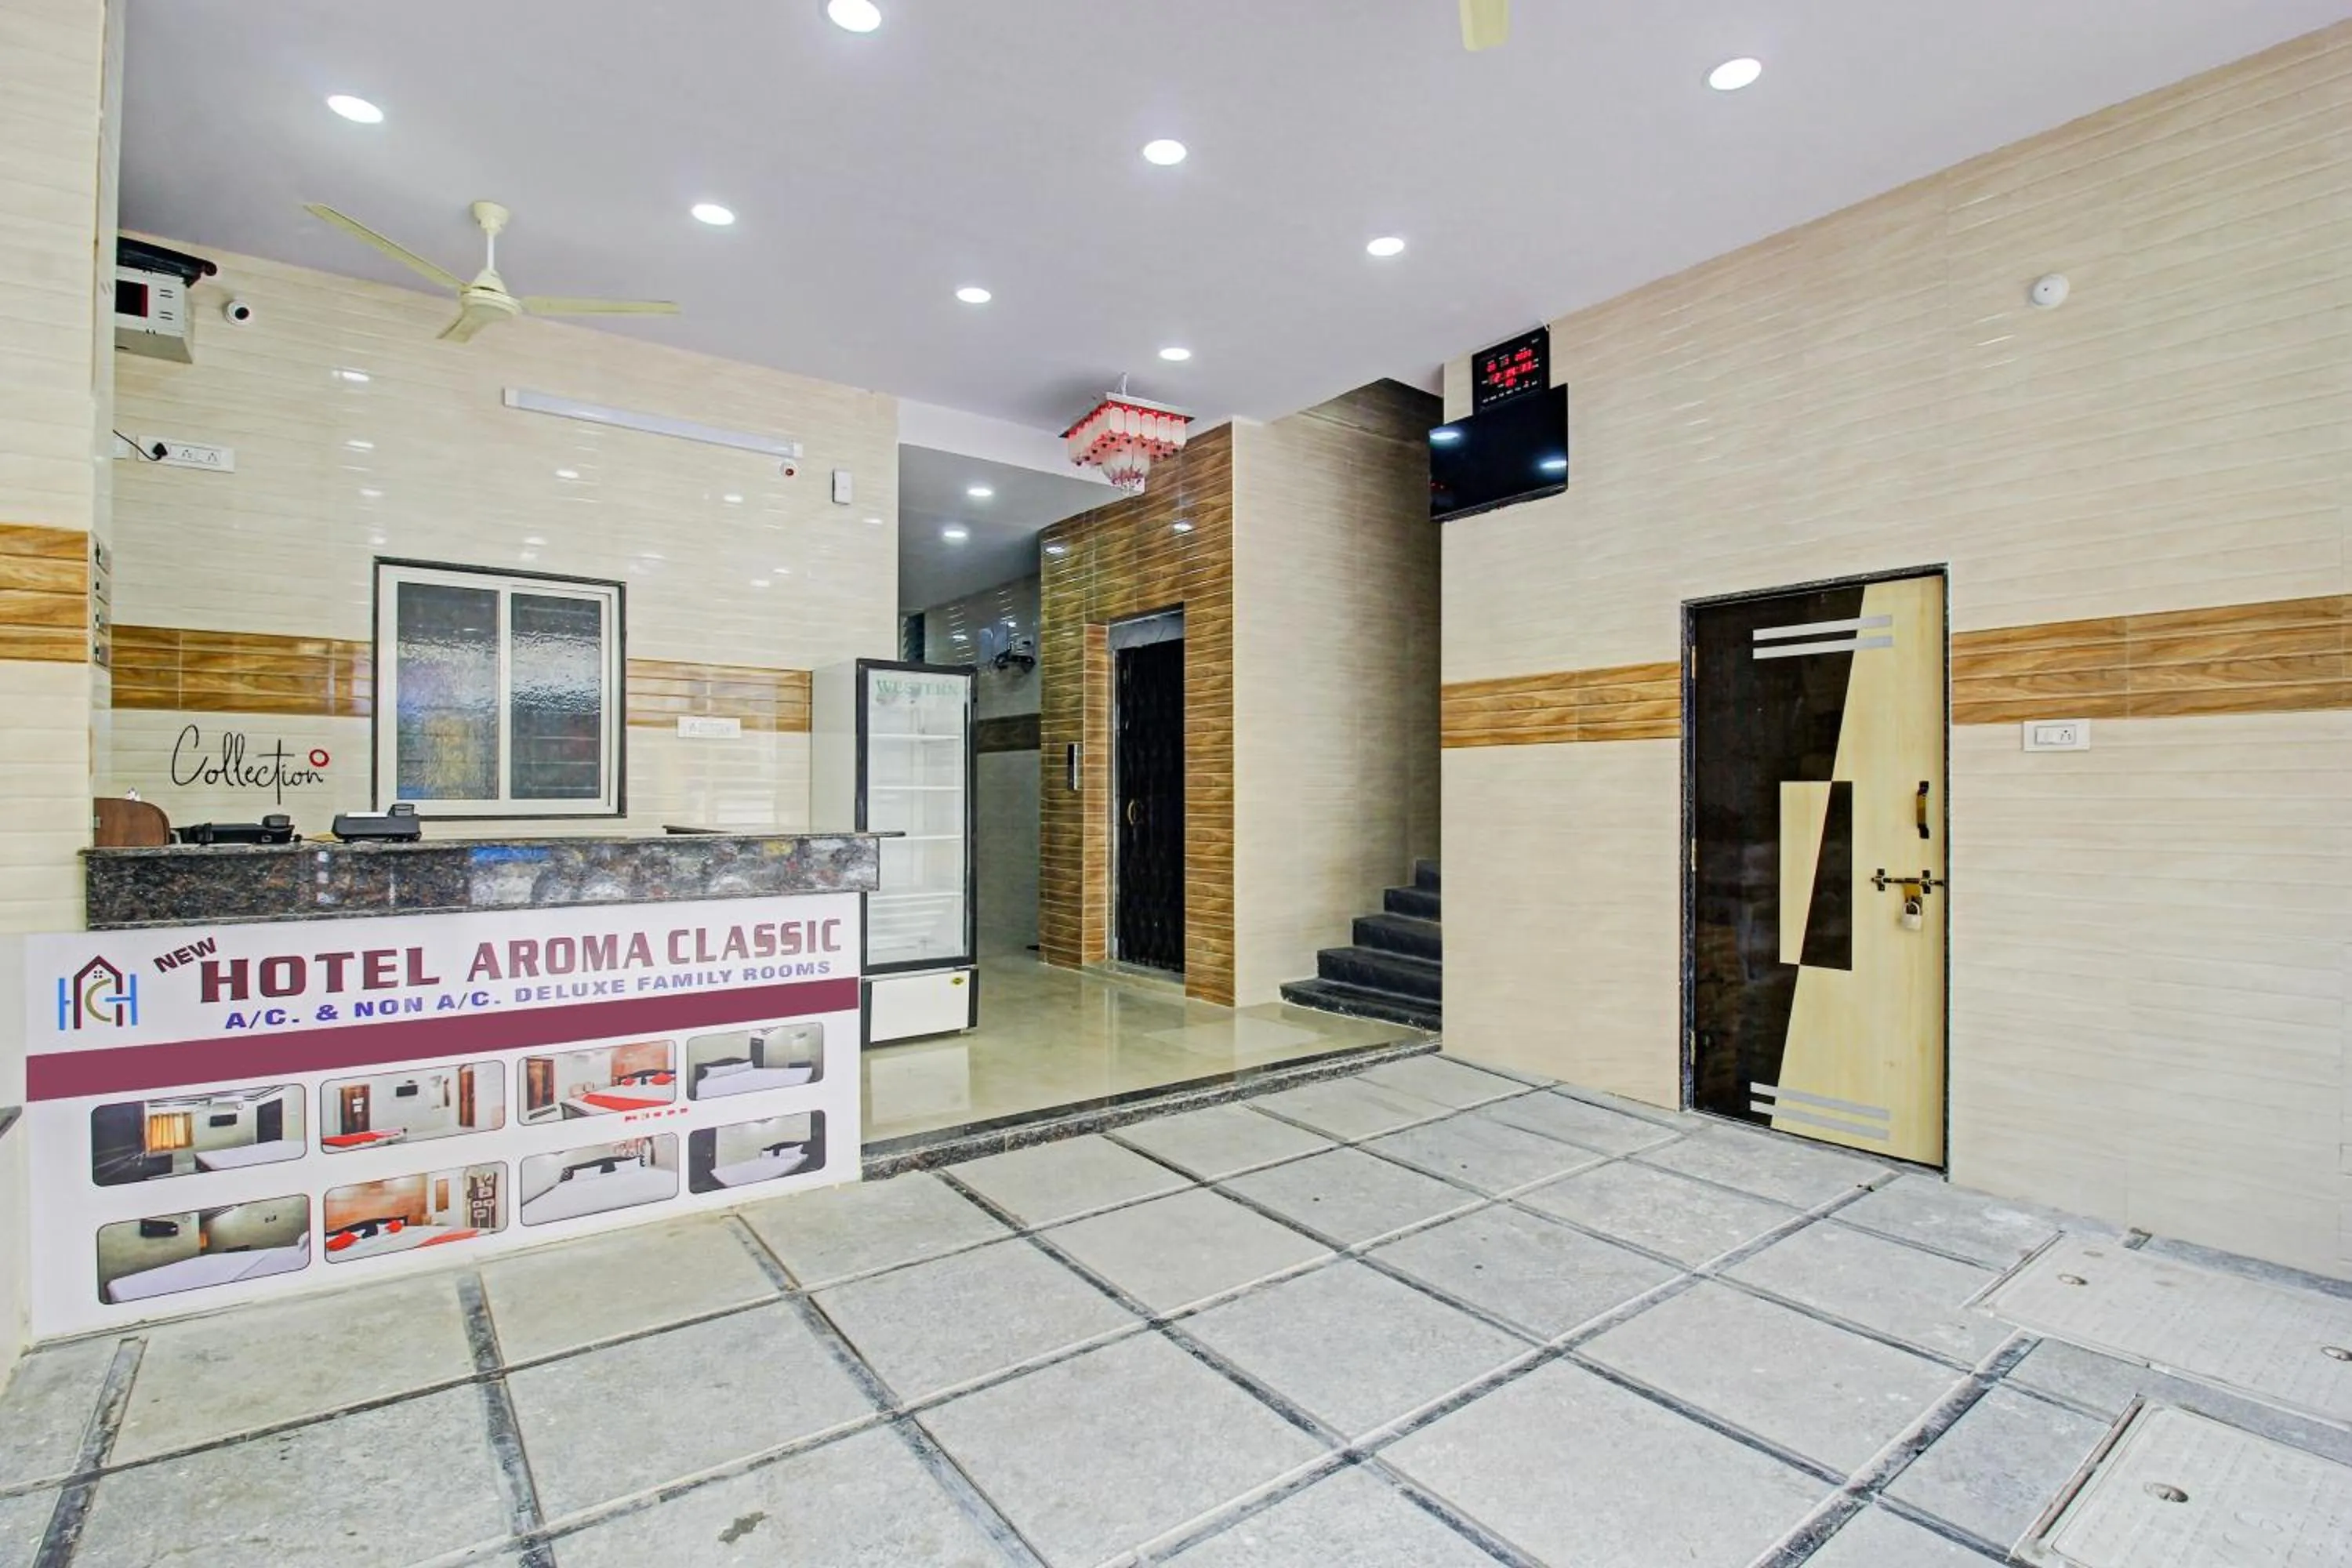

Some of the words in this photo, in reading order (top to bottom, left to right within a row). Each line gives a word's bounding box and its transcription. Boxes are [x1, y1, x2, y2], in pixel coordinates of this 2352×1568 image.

[172, 724, 324, 805] Collection
[153, 936, 217, 973] NEW
[201, 946, 441, 1004] HOTEL
[466, 931, 655, 982] AROMA
[667, 918, 842, 965] CLASSIC
[225, 1008, 300, 1029] A/C.
[316, 1004, 339, 1020] &
[354, 996, 423, 1018] NON
[437, 991, 502, 1011] A/C.
[515, 979, 626, 1003] DELUXE
[637, 969, 733, 991] FAMILY
[743, 960, 831, 982] ROOMS
